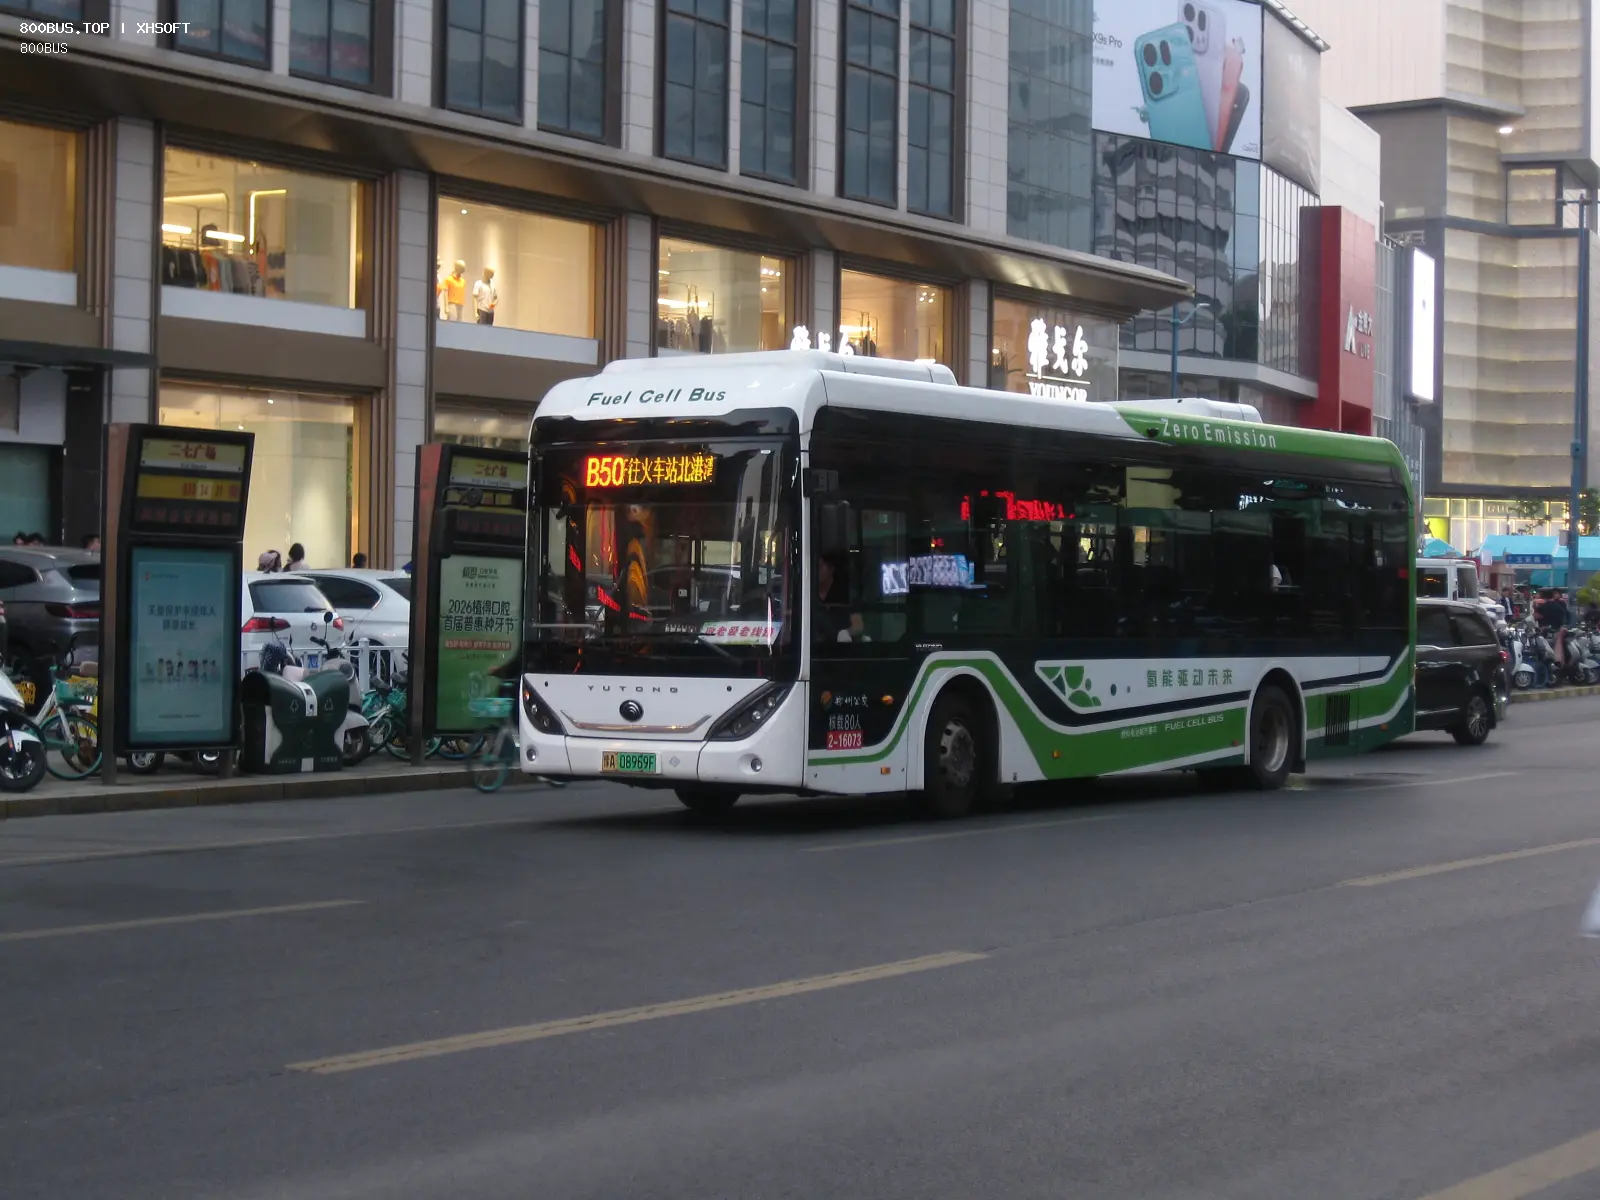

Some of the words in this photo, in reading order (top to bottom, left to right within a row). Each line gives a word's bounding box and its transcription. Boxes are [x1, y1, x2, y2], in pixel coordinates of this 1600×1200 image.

[1108, 35, 1123, 49] Pro
[1028, 317, 1089, 379] 雅戈尔
[586, 392, 632, 406] Fuel
[638, 389, 682, 403] Cell
[688, 388, 726, 402] Bus
[1161, 417, 1199, 440] Zero
[1203, 423, 1277, 449] Emission
[168, 444, 217, 460] 二七广场
[586, 457, 624, 487] B50
[1146, 668, 1233, 688] 氢能驱动未来
[587, 685, 678, 693] YUTONG
[828, 714, 861, 731] 核载80人
[1165, 721, 1186, 732] FUEL
[1187, 718, 1206, 728] CELL
[1208, 714, 1225, 724] BUS
[828, 733, 862, 748] 2-16073
